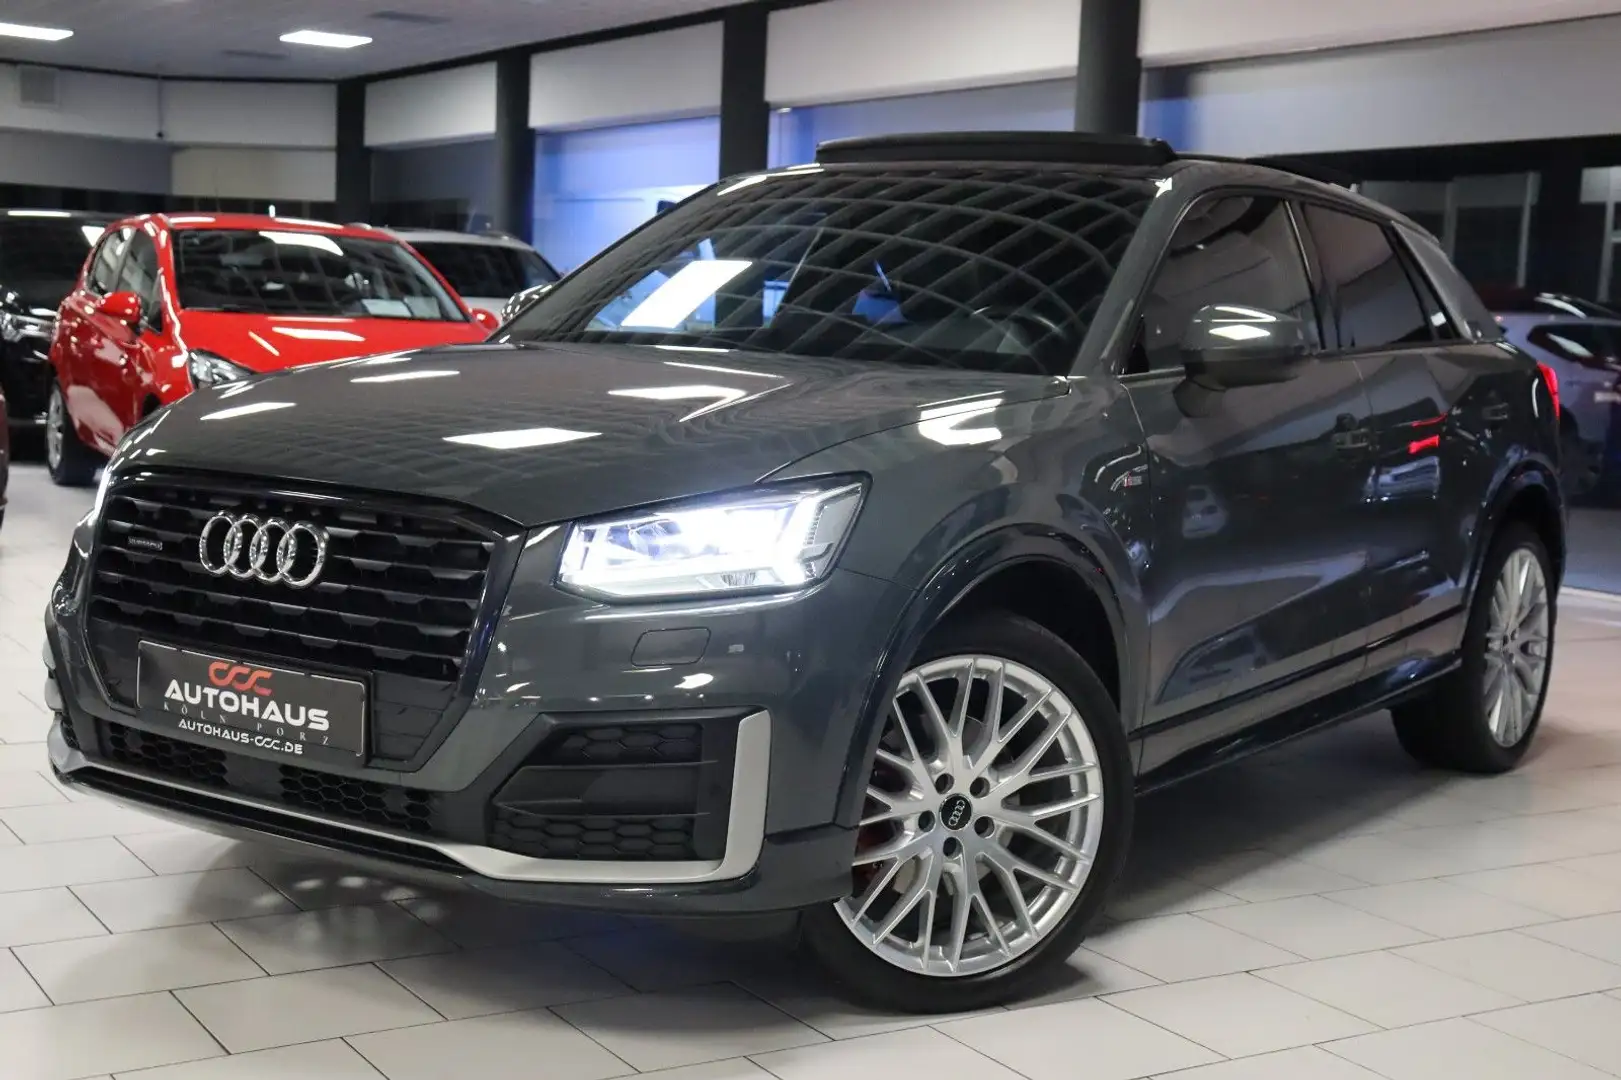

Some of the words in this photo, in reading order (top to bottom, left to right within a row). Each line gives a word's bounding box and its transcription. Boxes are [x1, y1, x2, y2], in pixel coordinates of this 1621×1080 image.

[164, 679, 330, 731] AUTOHAUS
[164, 702, 227, 724] KÖLN
[257, 722, 330, 746] PORZ
[178, 718, 303, 754] AUTOHAUS-CCC.DE
